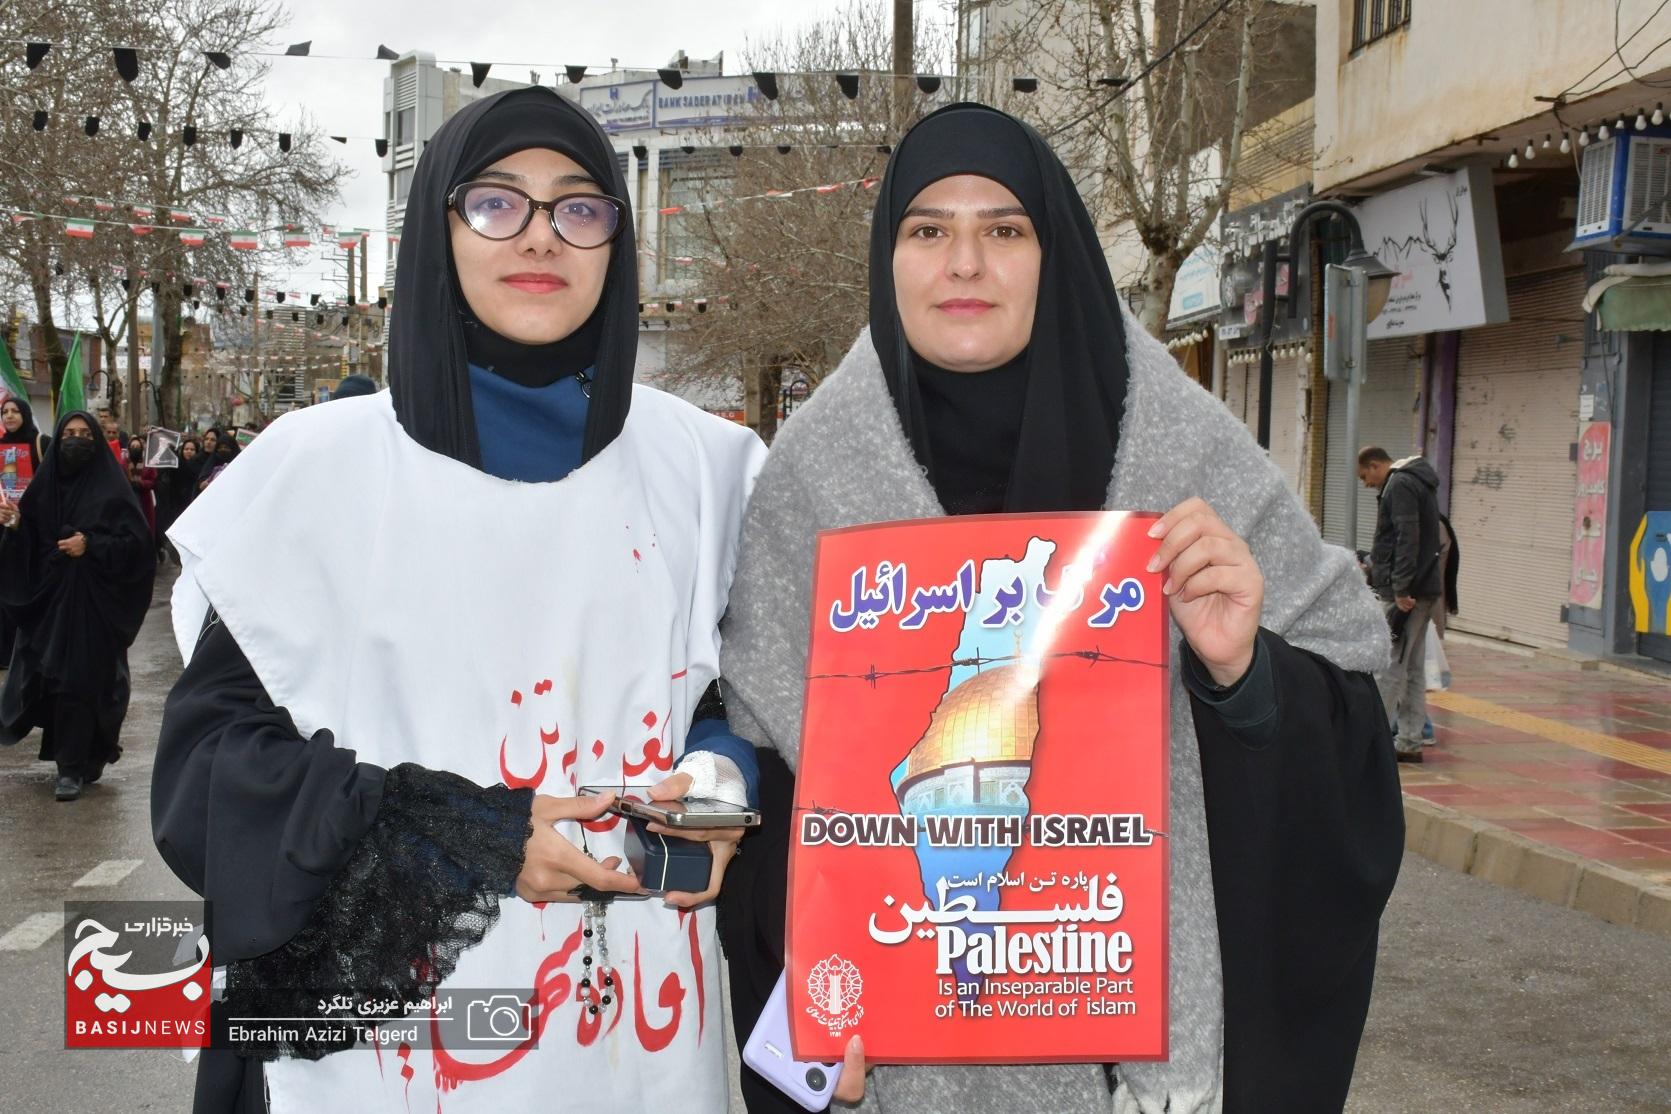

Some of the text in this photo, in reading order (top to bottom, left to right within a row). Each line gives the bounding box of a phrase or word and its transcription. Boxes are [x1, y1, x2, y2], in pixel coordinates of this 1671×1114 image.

[658, 95, 682, 109] BANK
[683, 94, 722, 107] SADERAT
[829, 560, 976, 633] اسرائیل
[980, 573, 1025, 628] بر
[800, 812, 1155, 847] DOWN WITH ISRAEL
[947, 871, 1089, 892] پاره تن اسلام است
[868, 872, 1124, 945] فلسطین
[935, 923, 1133, 975] Palestine
[938, 976, 1133, 998] Is an Inseparable Part
[935, 996, 1136, 1017] of The World of islam
